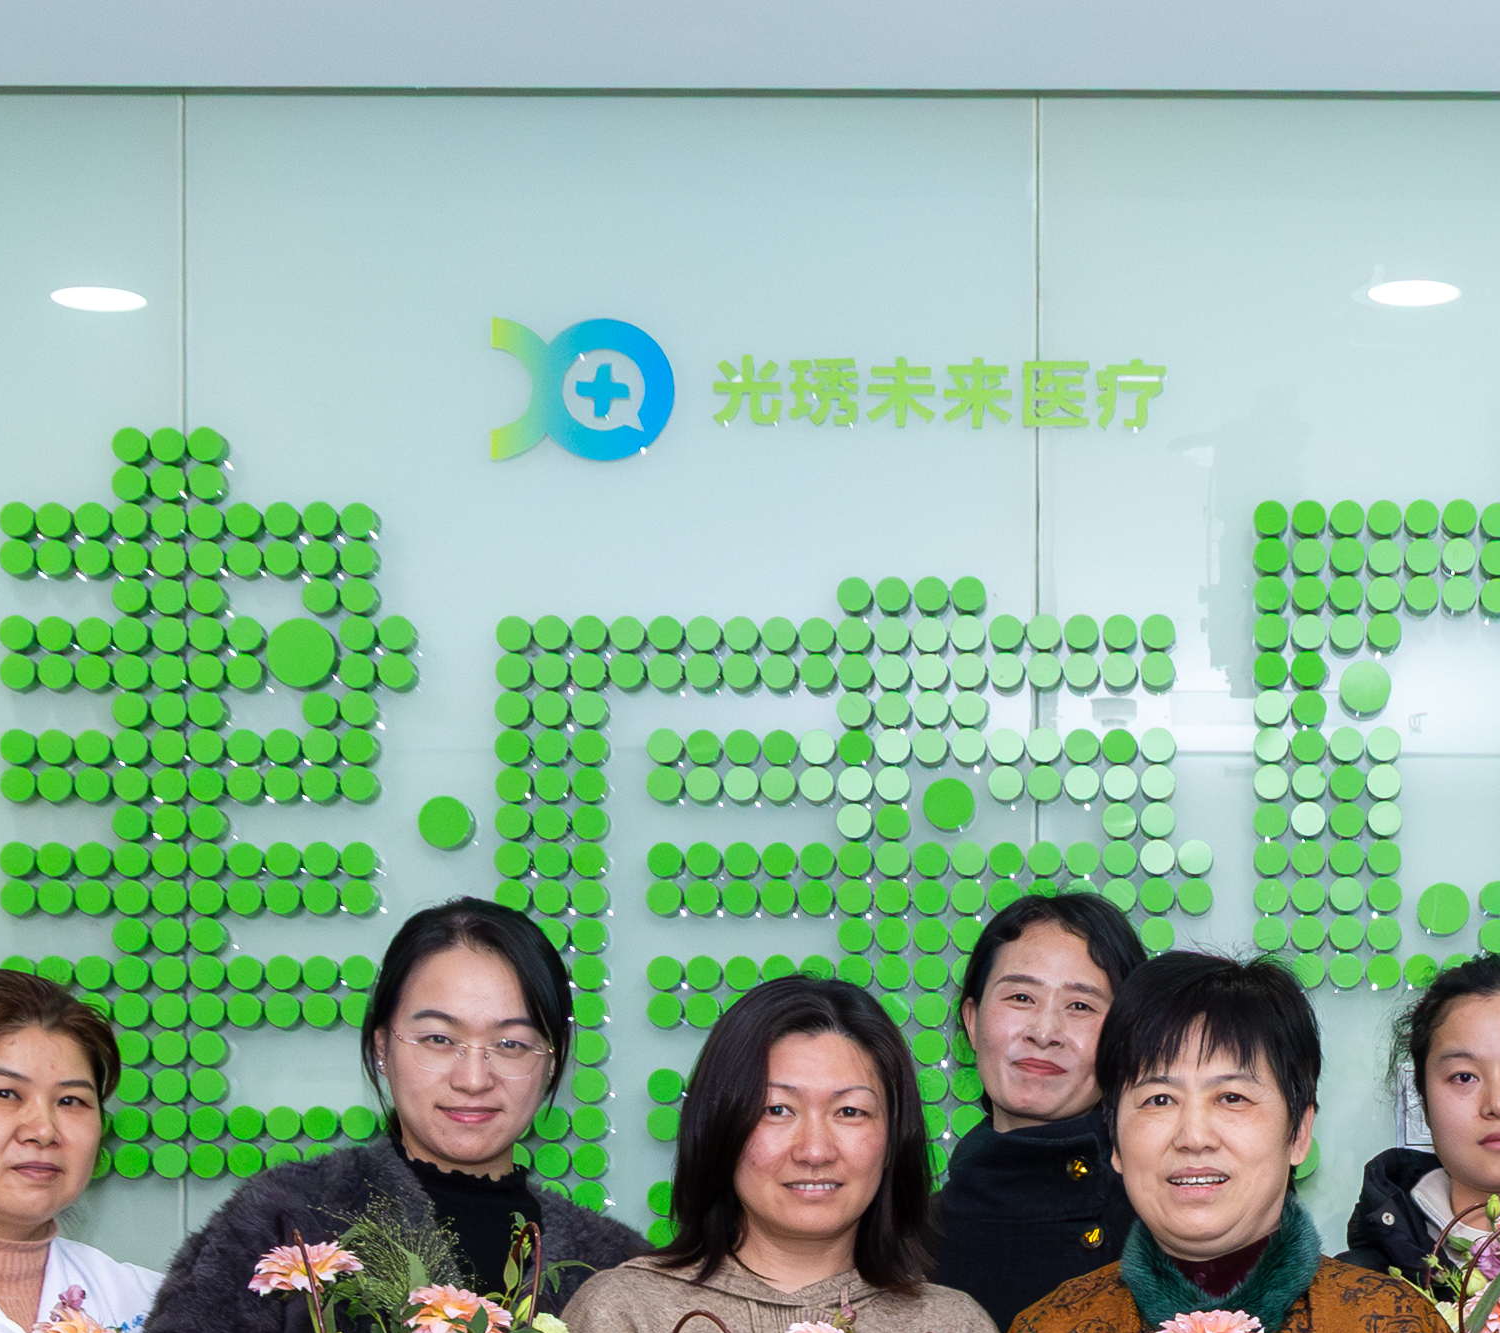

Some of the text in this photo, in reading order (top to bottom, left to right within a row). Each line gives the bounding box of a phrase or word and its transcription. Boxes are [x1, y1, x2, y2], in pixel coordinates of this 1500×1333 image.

[712, 354, 1167, 429] 光琇未来医疗
